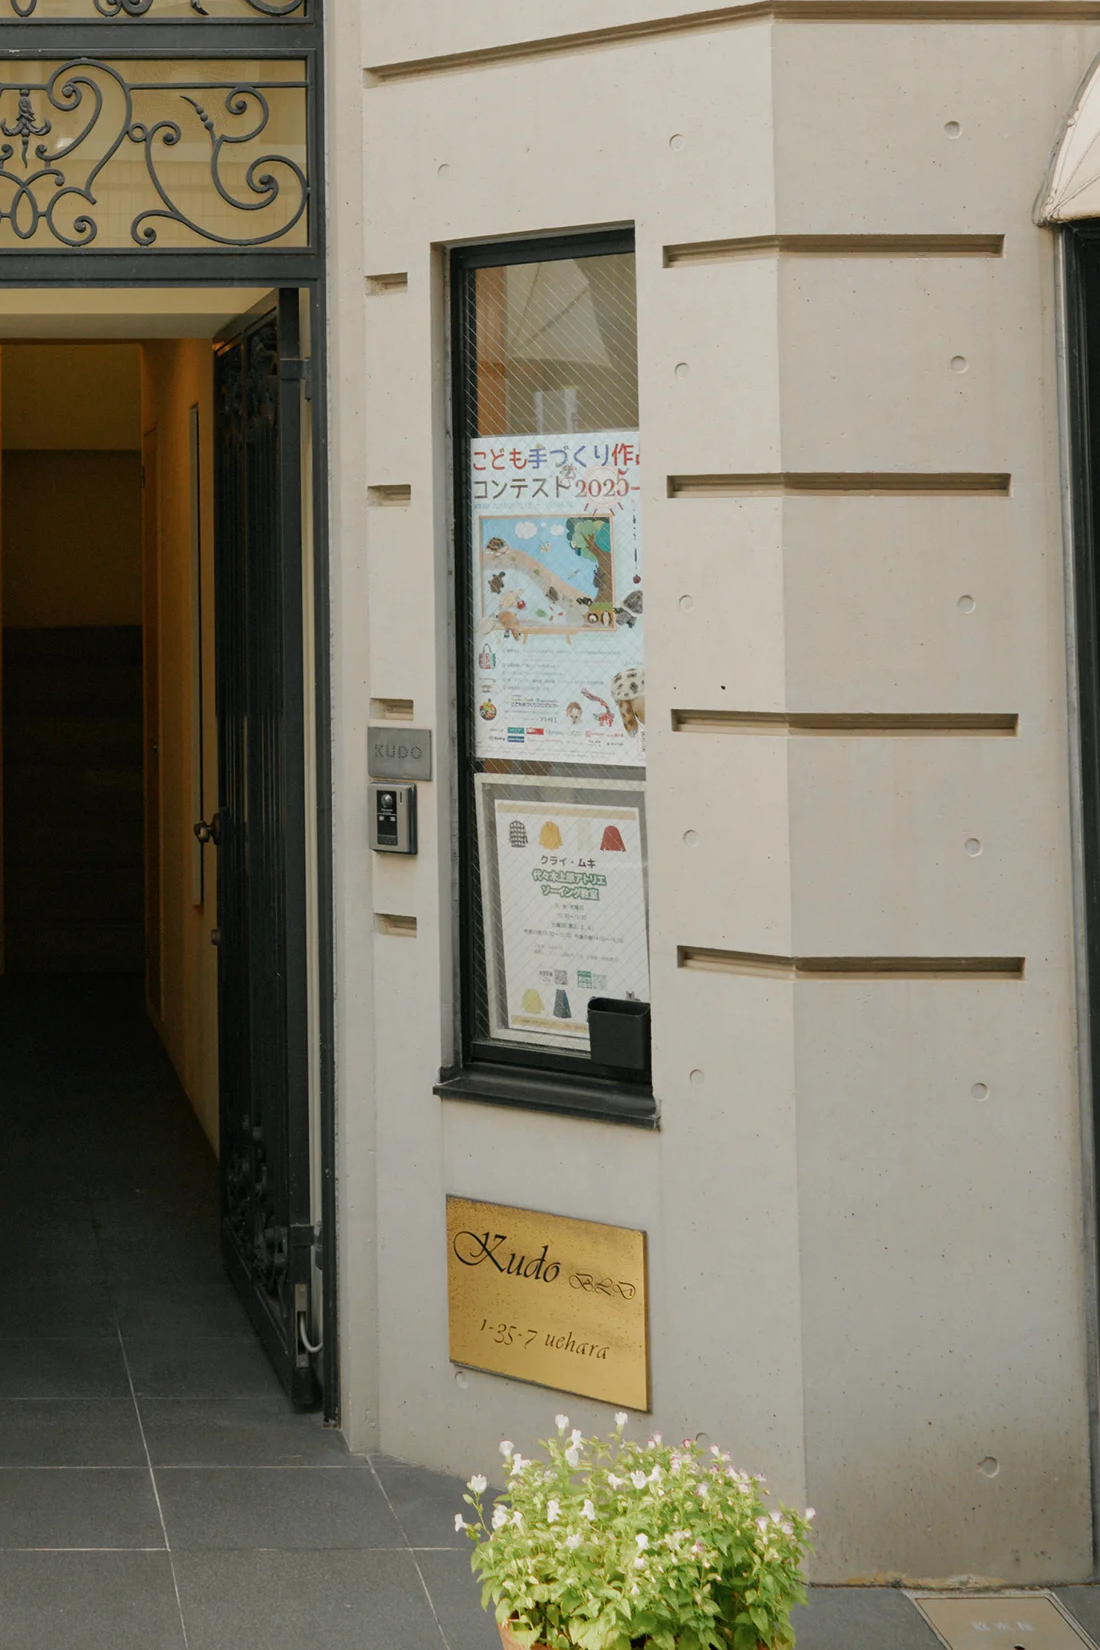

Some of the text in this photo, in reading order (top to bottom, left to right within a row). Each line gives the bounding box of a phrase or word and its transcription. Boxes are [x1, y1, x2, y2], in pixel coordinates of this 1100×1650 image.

[540, 855, 596, 868] クライ・ムキ
[453, 1231, 561, 1283] Kudo
[480, 1319, 610, 1360] 1-35-7 uehara
